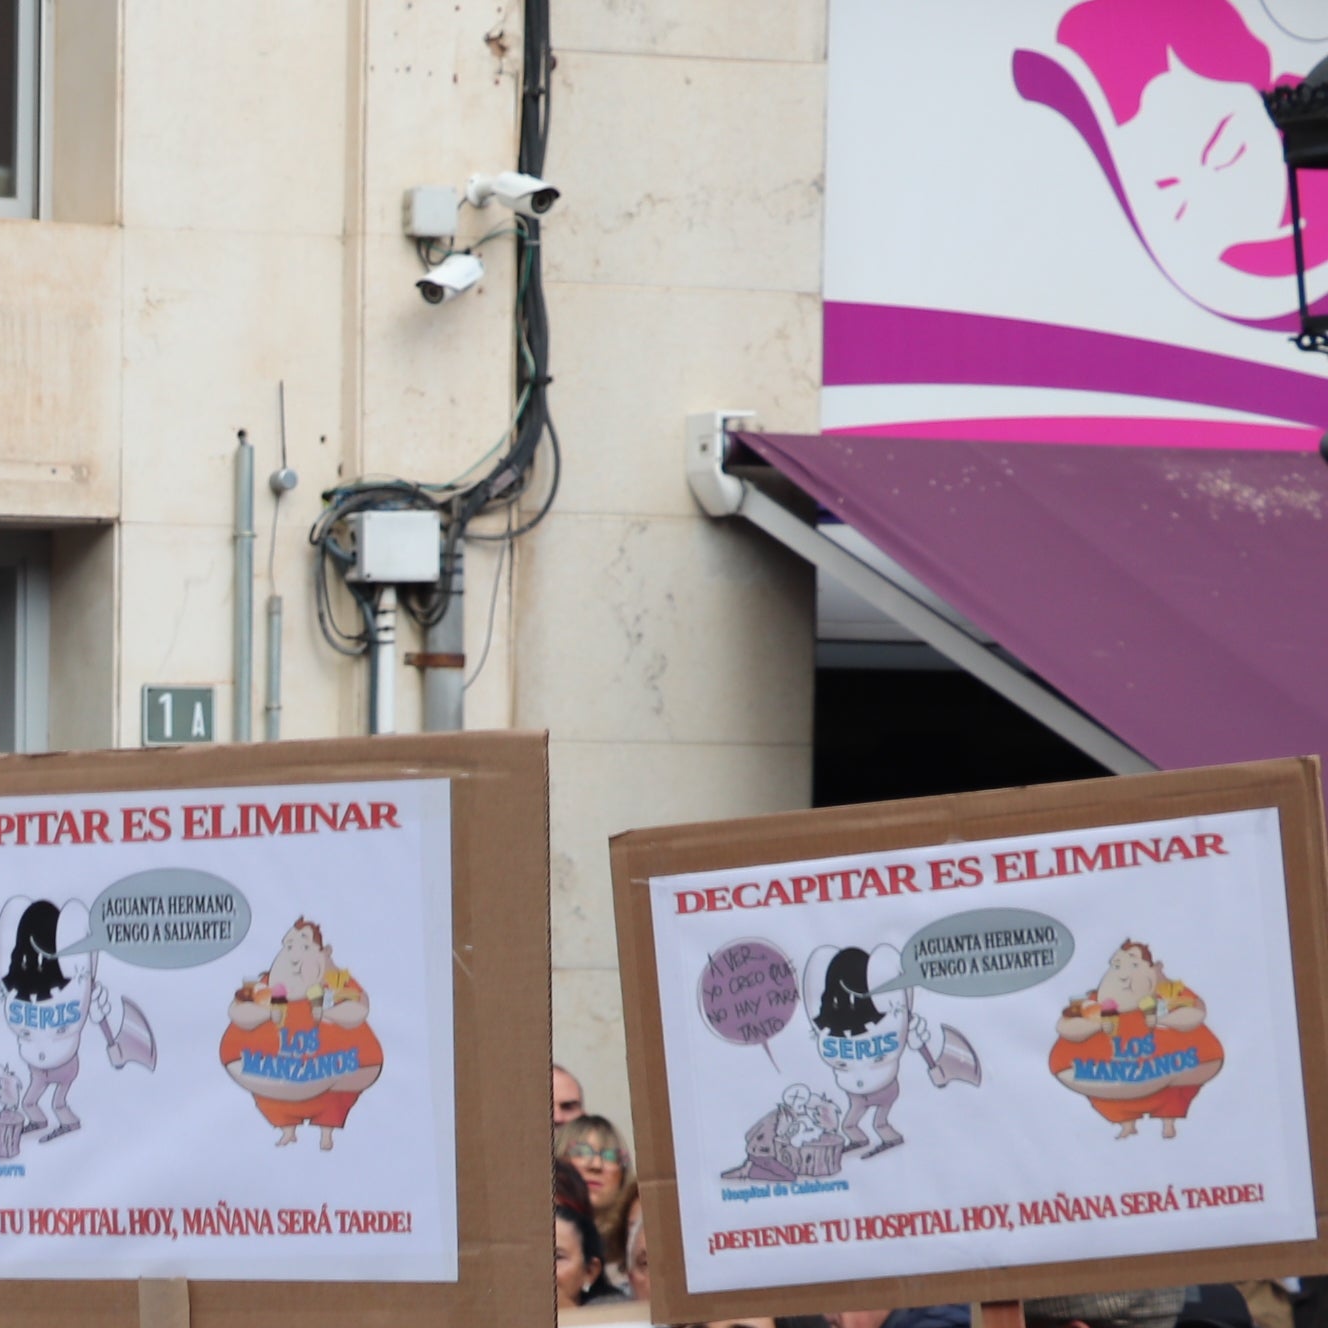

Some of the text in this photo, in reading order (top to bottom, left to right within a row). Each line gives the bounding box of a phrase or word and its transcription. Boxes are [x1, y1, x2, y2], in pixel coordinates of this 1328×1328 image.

[158, 692, 205, 738] 1 A
[121, 806, 172, 842] ES
[181, 801, 402, 841] ELIMINAR
[674, 832, 1229, 916] DECAPITAR ES ELIMINAR
[101, 894, 236, 922] ¡AGUANTA HERMANO,
[106, 920, 231, 943] VENGO A SALVARTE!
[914, 926, 1057, 961] ¡AGUANTA HERMANO,
[920, 949, 1055, 980] VENGO A SALVARTE!
[729, 971, 765, 995] CREO
[8, 1000, 81, 1029] SERIS
[735, 996, 761, 1019] HAY
[280, 1027, 321, 1056] LOS
[737, 1016, 785, 1042] TANTO
[822, 1032, 900, 1061] SERIS
[1112, 1033, 1156, 1060] LOS
[241, 1048, 359, 1083] MANZANOS
[1074, 1048, 1199, 1084] MANZANOS
[27, 1208, 127, 1236] HOSPITAL
[128, 1207, 179, 1240] HOY,
[182, 1200, 274, 1236] MAÑANA
[277, 1203, 333, 1235] SERÁ
[335, 1209, 412, 1234] TARDE!
[709, 1184, 1264, 1255] ¡DEFIENDE TU HOSPITAL HOY, MAÑANA SERÁ TARDE!
